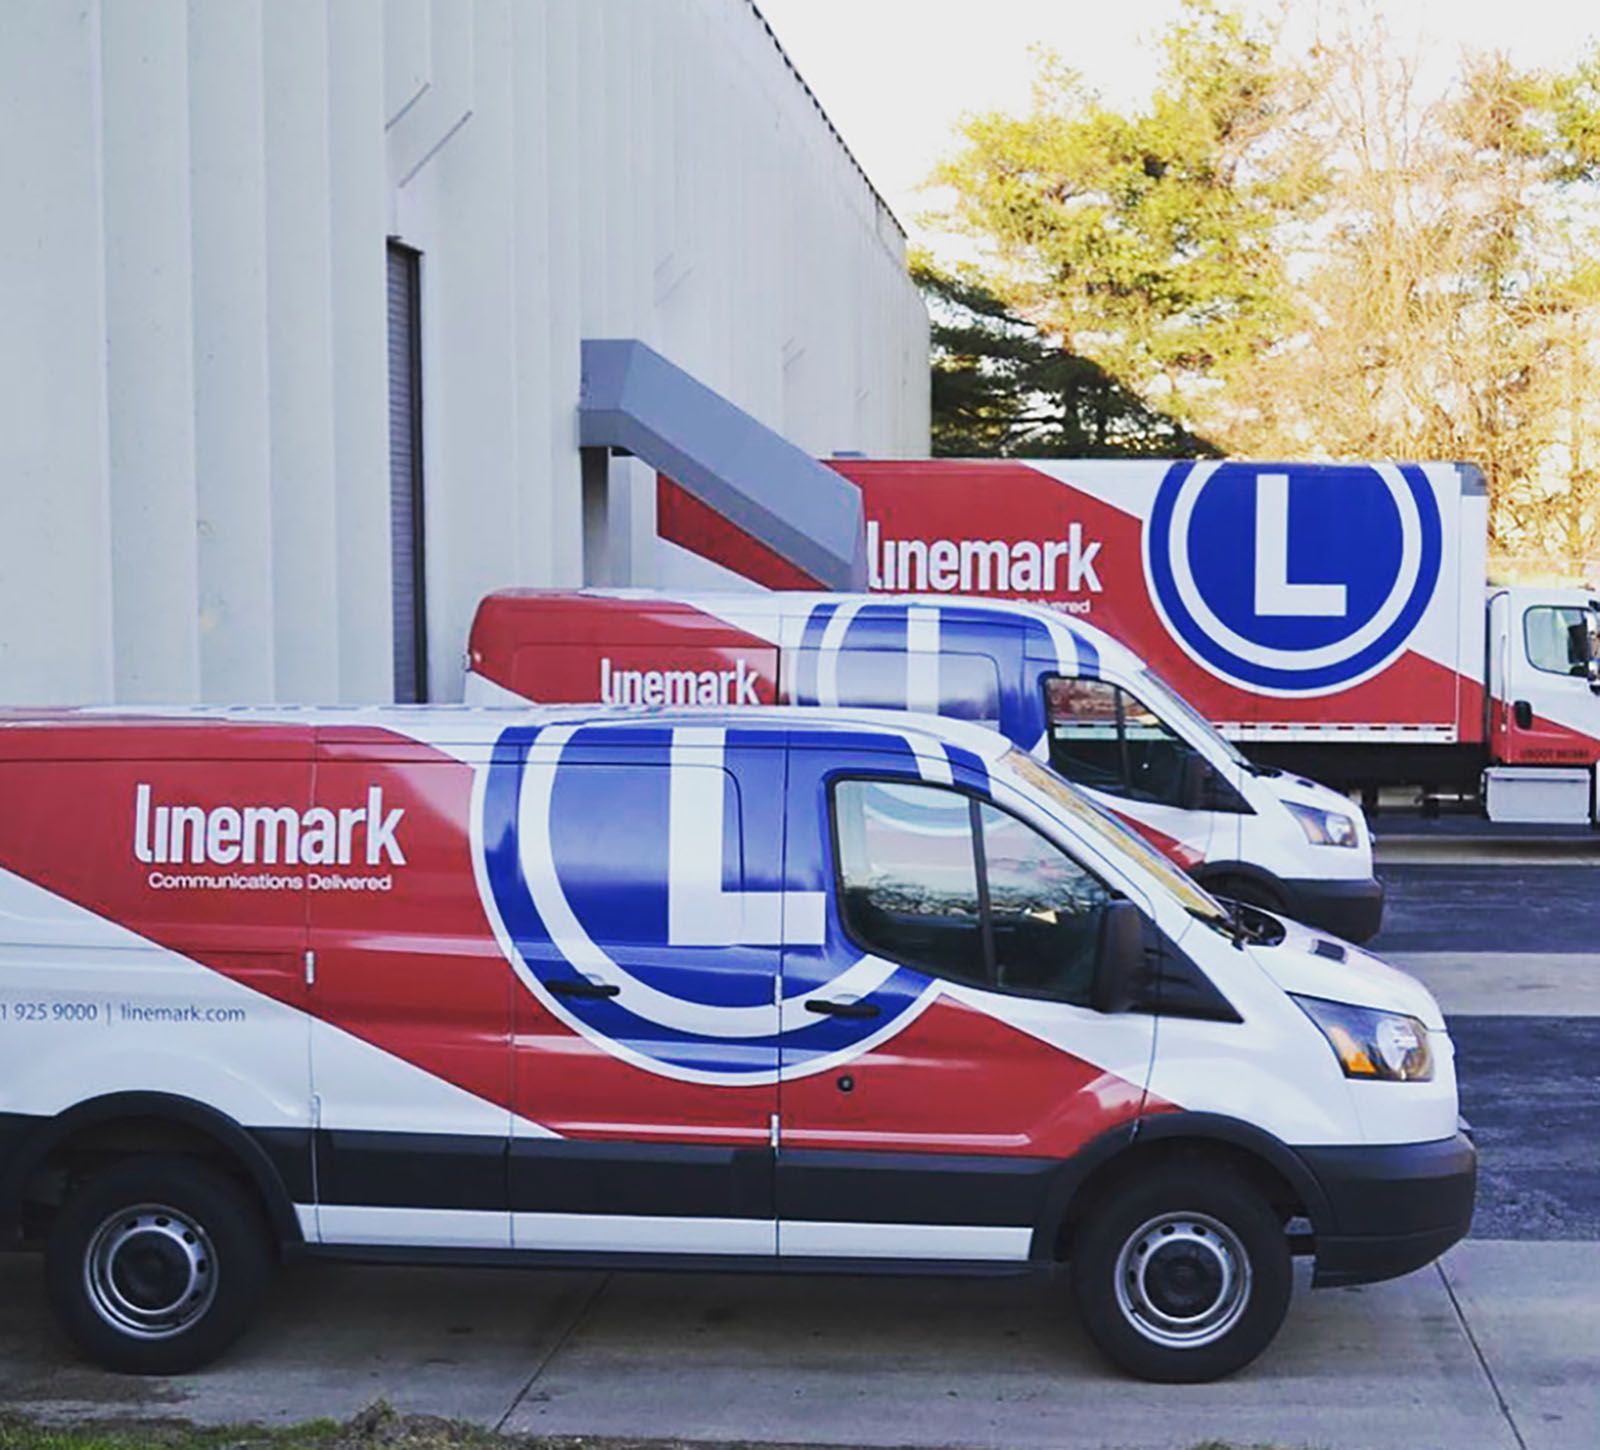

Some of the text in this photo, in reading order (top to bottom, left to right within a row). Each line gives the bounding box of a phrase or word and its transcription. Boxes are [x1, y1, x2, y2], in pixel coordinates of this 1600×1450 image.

[867, 520, 1102, 592] linemark
[1255, 474, 1347, 616] L
[601, 657, 760, 704] linemark
[134, 783, 406, 866] linemark
[668, 727, 826, 946] L
[149, 872, 393, 891] Communications Delivered
[14, 1003, 47, 1021] 925
[52, 1003, 98, 1021] 9000
[120, 1003, 247, 1023] linemark.com
